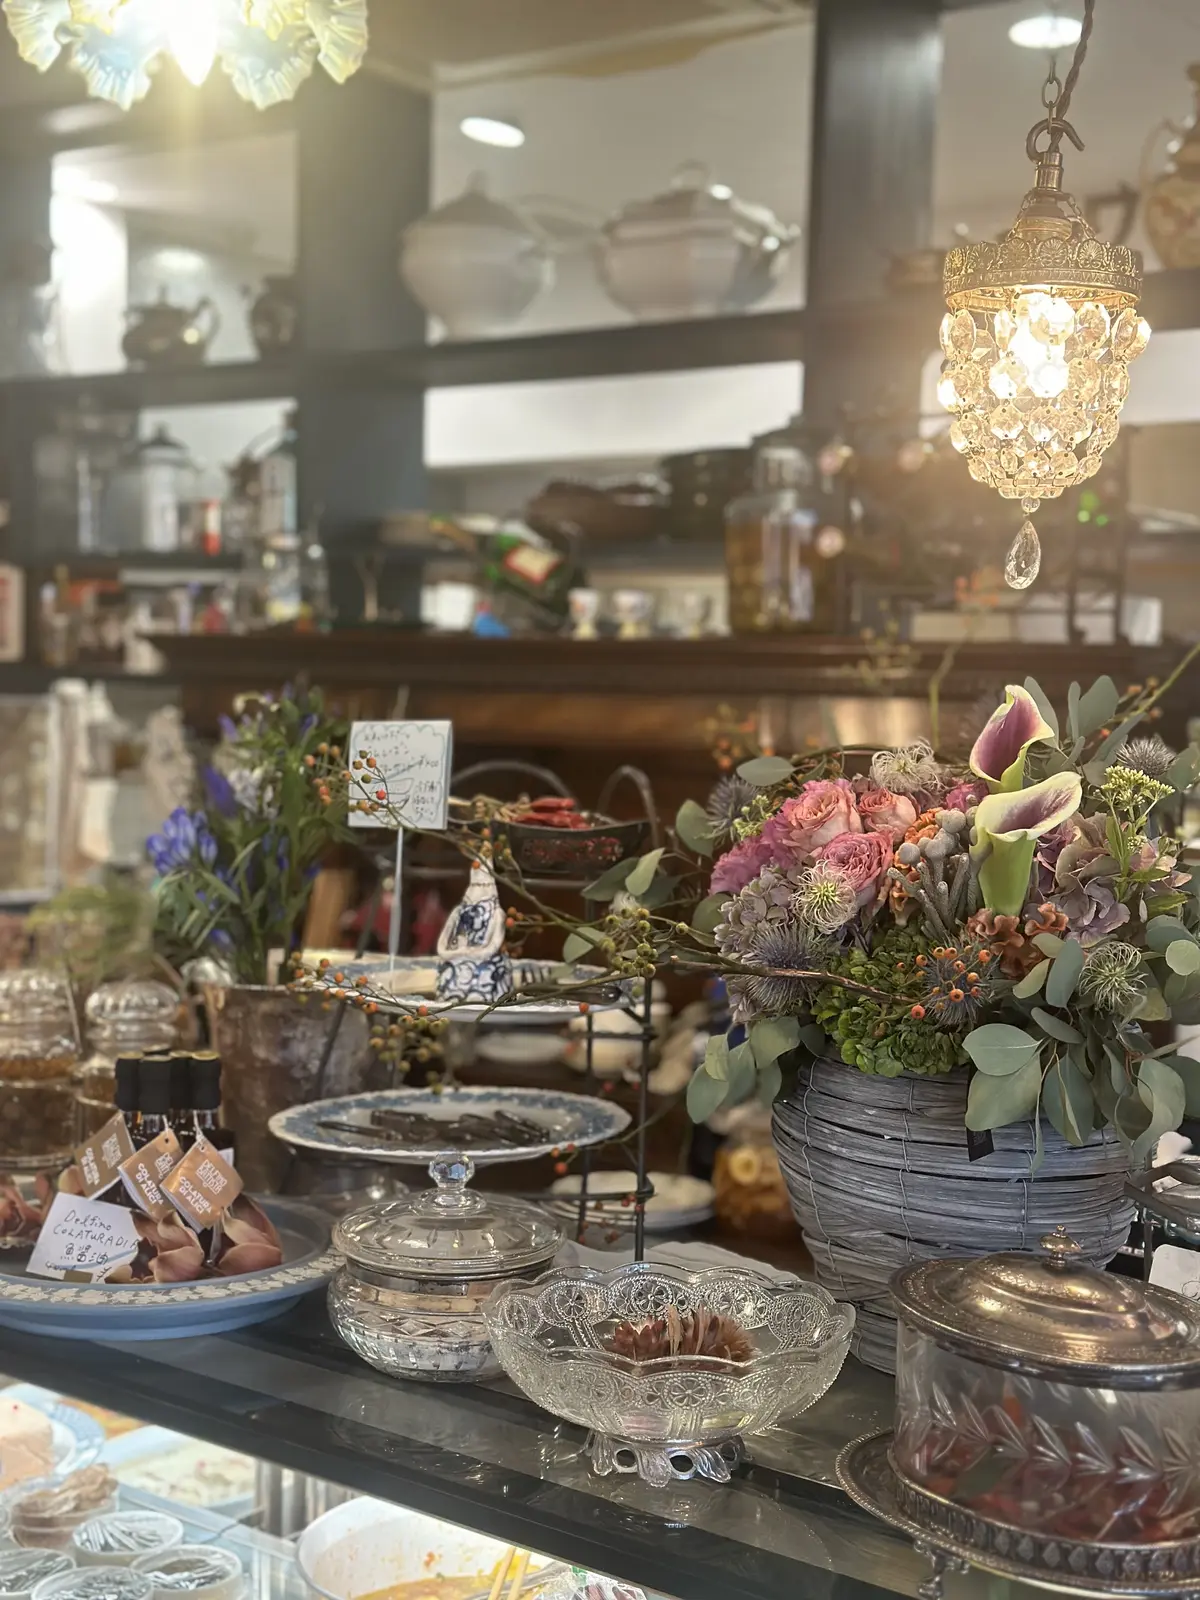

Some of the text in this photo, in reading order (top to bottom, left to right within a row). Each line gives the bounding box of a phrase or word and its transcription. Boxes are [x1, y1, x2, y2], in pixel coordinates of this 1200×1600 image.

[136, 1172, 157, 1204] DI ALICI
[138, 1163, 164, 1204] COLATURA
[180, 1176, 212, 1213] COLATURA
[179, 1186, 205, 1214] DI ALICI
[64, 1209, 112, 1231] Delfino
